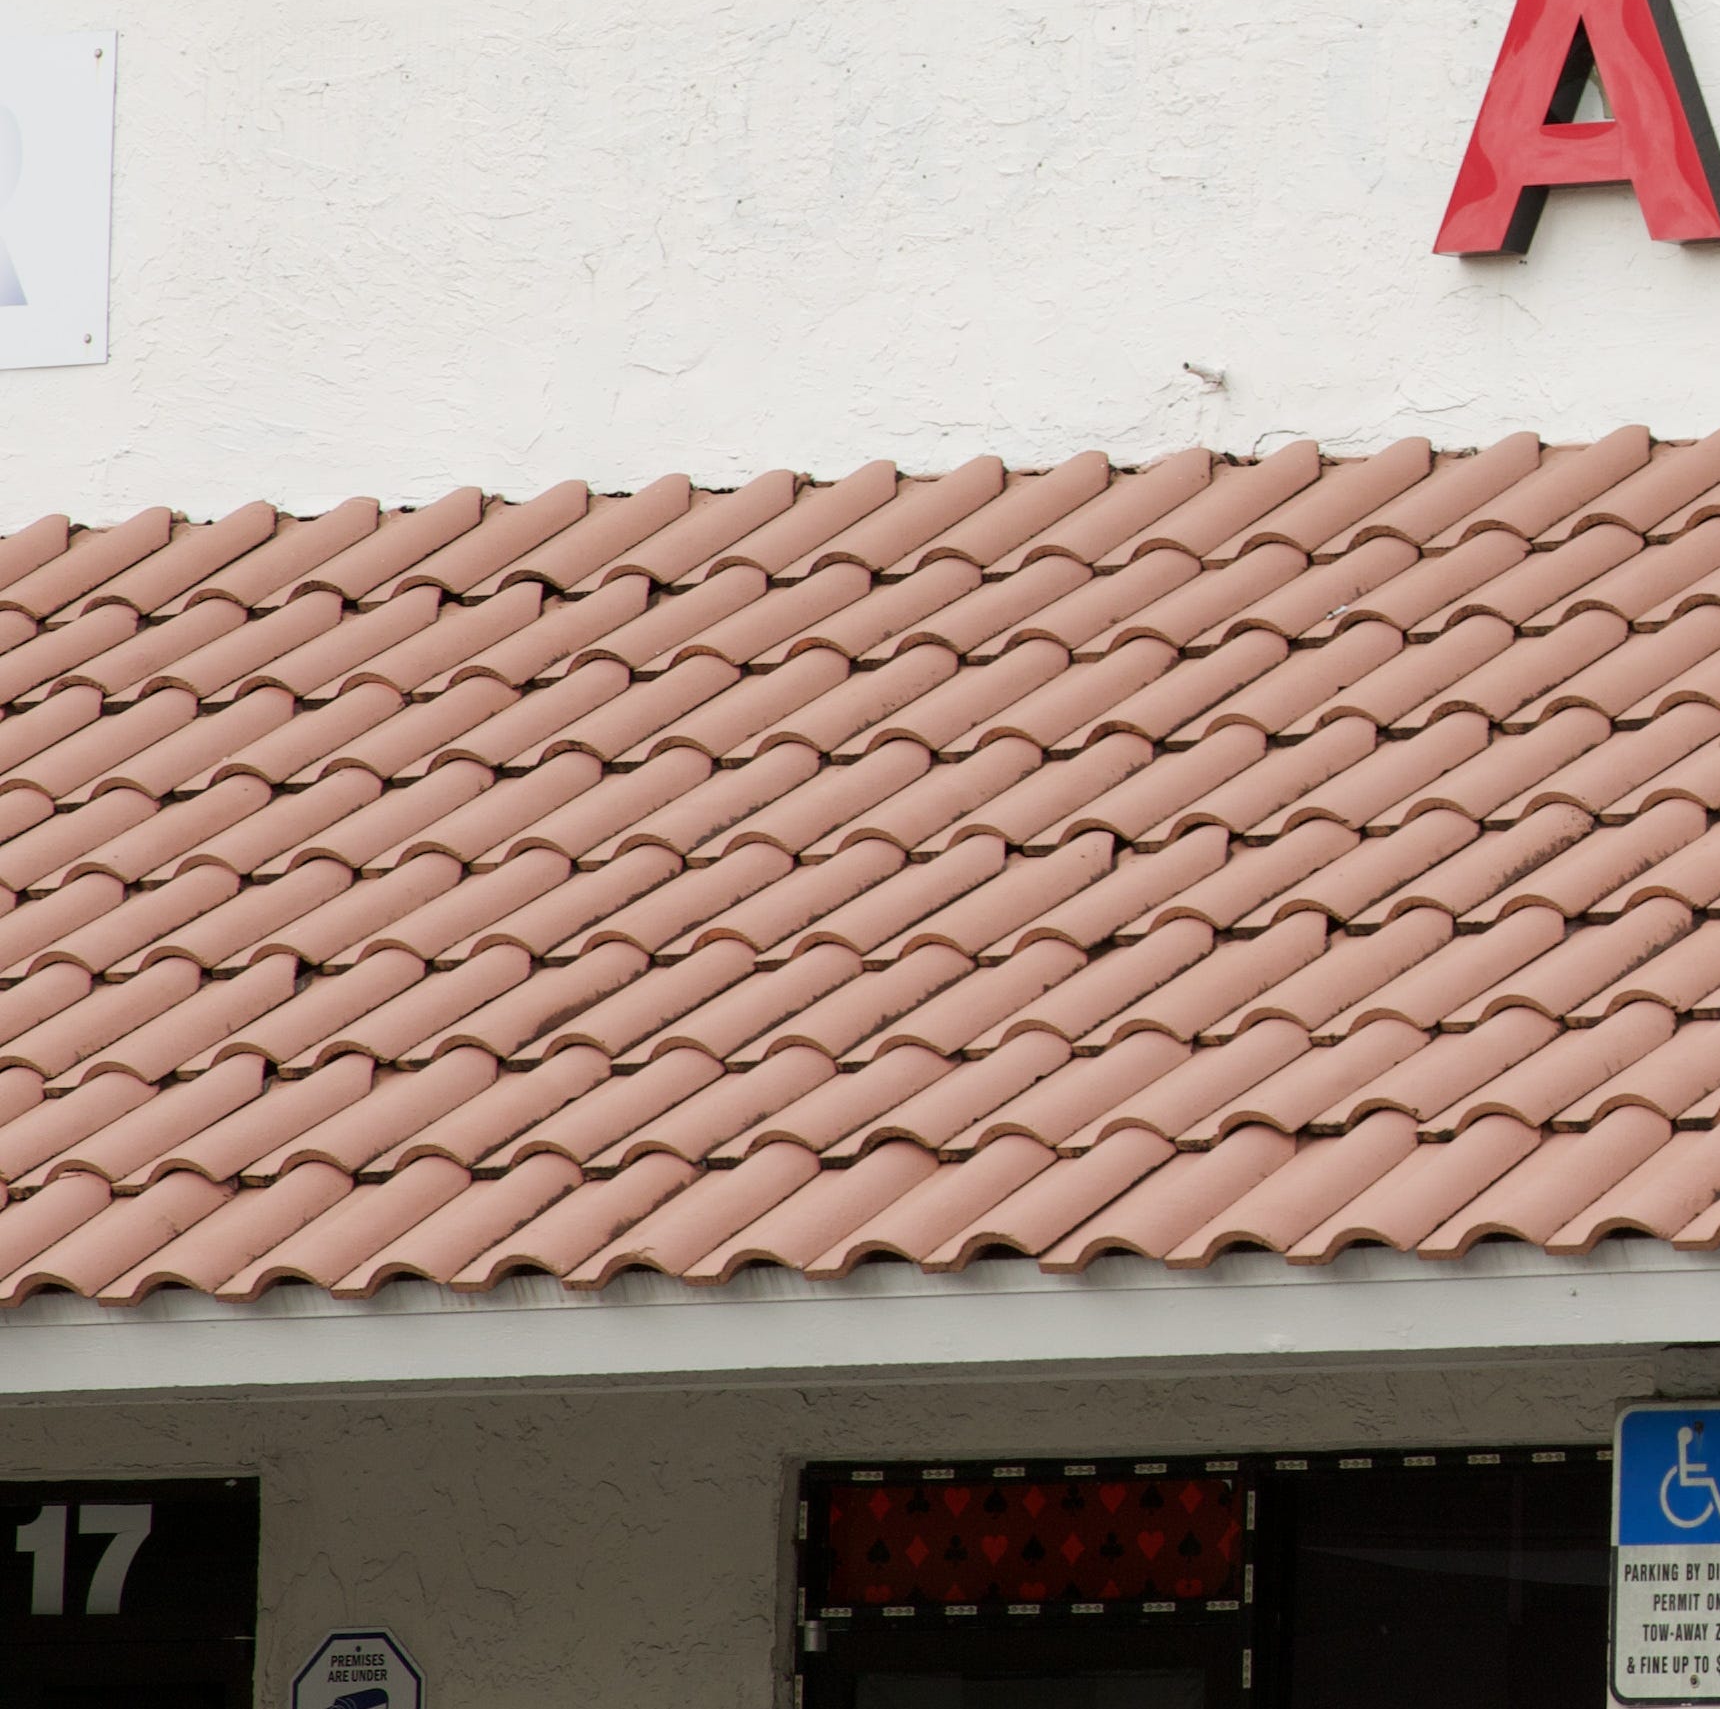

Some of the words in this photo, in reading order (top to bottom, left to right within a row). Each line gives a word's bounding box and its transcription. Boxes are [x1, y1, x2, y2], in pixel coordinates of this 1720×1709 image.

[15, 1503, 153, 1615] 17
[1623, 1563, 1680, 1582] PARKING
[1686, 1563, 1701, 1581] BY
[1652, 1593, 1701, 1612] PERMIT
[1642, 1622, 1709, 1642] TOW-AWAY
[331, 1653, 385, 1667] PREMISES
[1626, 1656, 1636, 1674] &
[1640, 1656, 1668, 1674] FINE
[1672, 1655, 1689, 1674] UP
[1693, 1655, 1710, 1674] TO
[328, 1670, 349, 1682] ARE
[351, 1668, 388, 1682] UNDER
